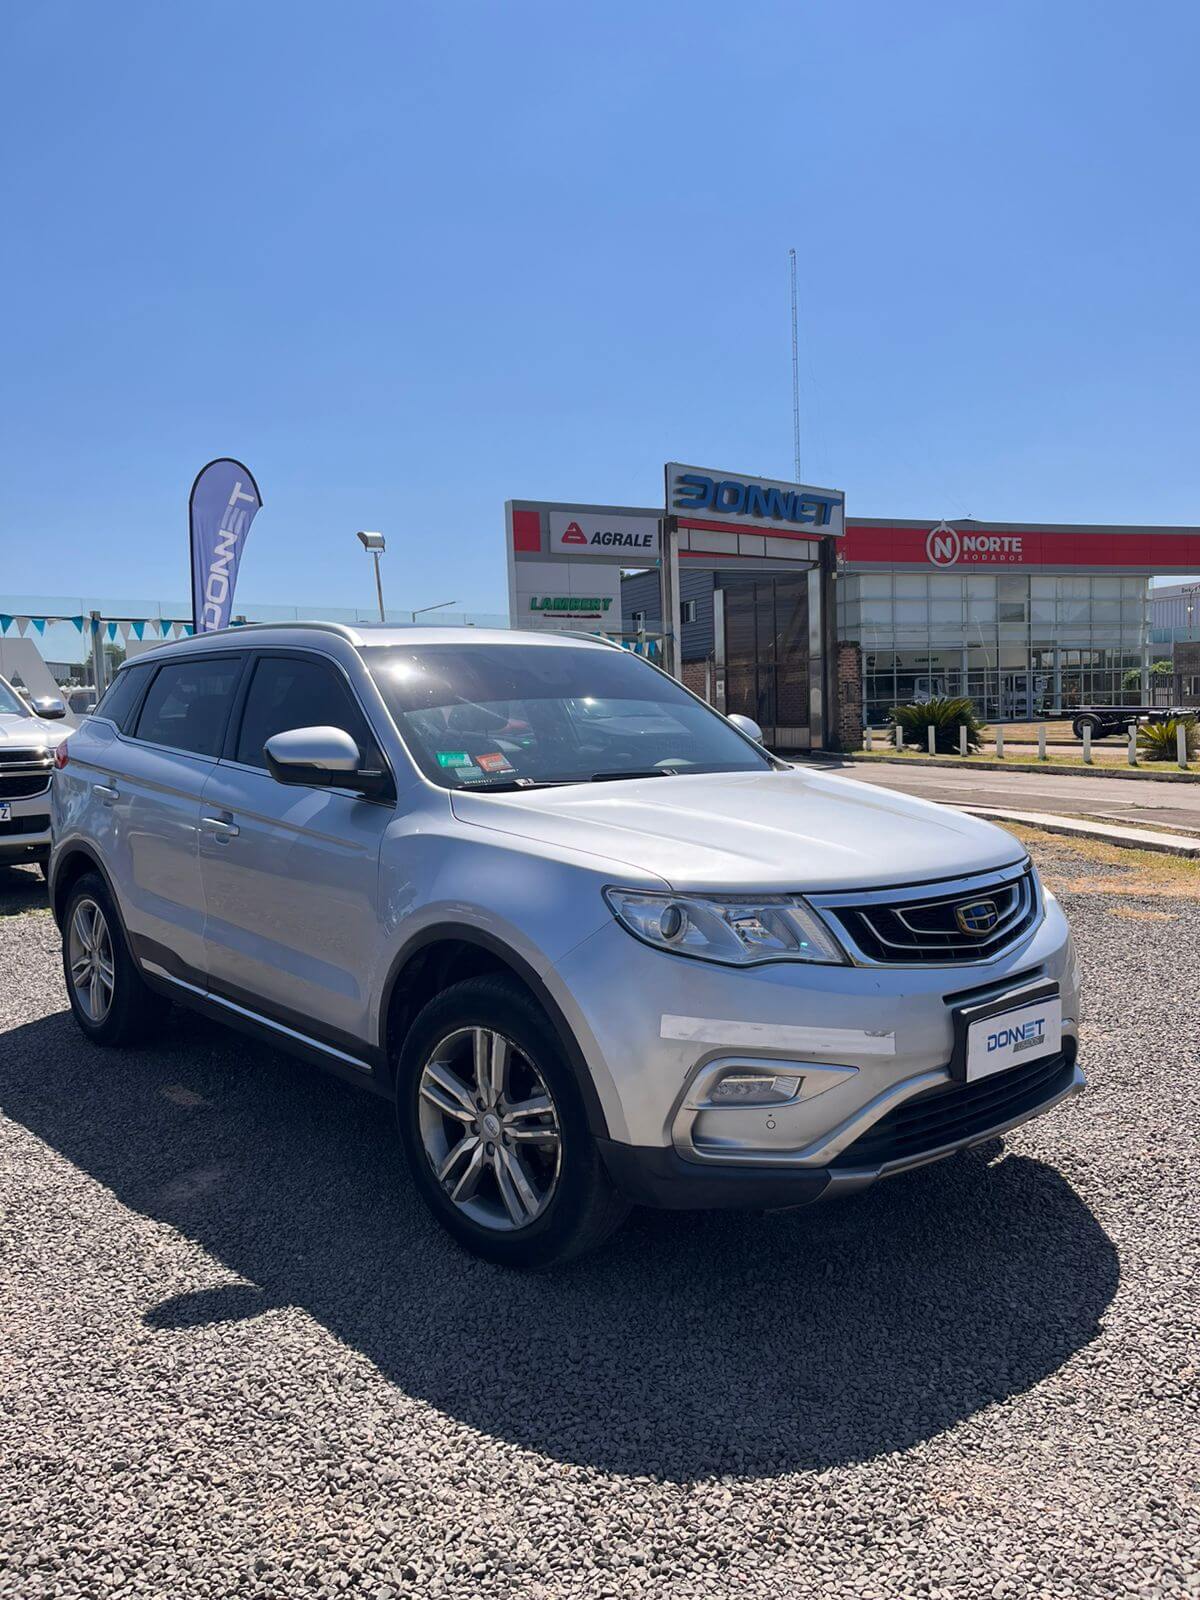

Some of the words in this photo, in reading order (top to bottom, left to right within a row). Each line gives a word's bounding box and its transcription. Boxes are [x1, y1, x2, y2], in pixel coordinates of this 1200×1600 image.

[674, 474, 842, 526] DONNET
[590, 531, 654, 548] AGRALE
[962, 535, 1023, 553] NORTE
[200, 481, 255, 631] DONNET
[963, 553, 1023, 562] RODADOS
[530, 597, 613, 611] LAMBERT
[987, 1018, 1046, 1053] DONNET
